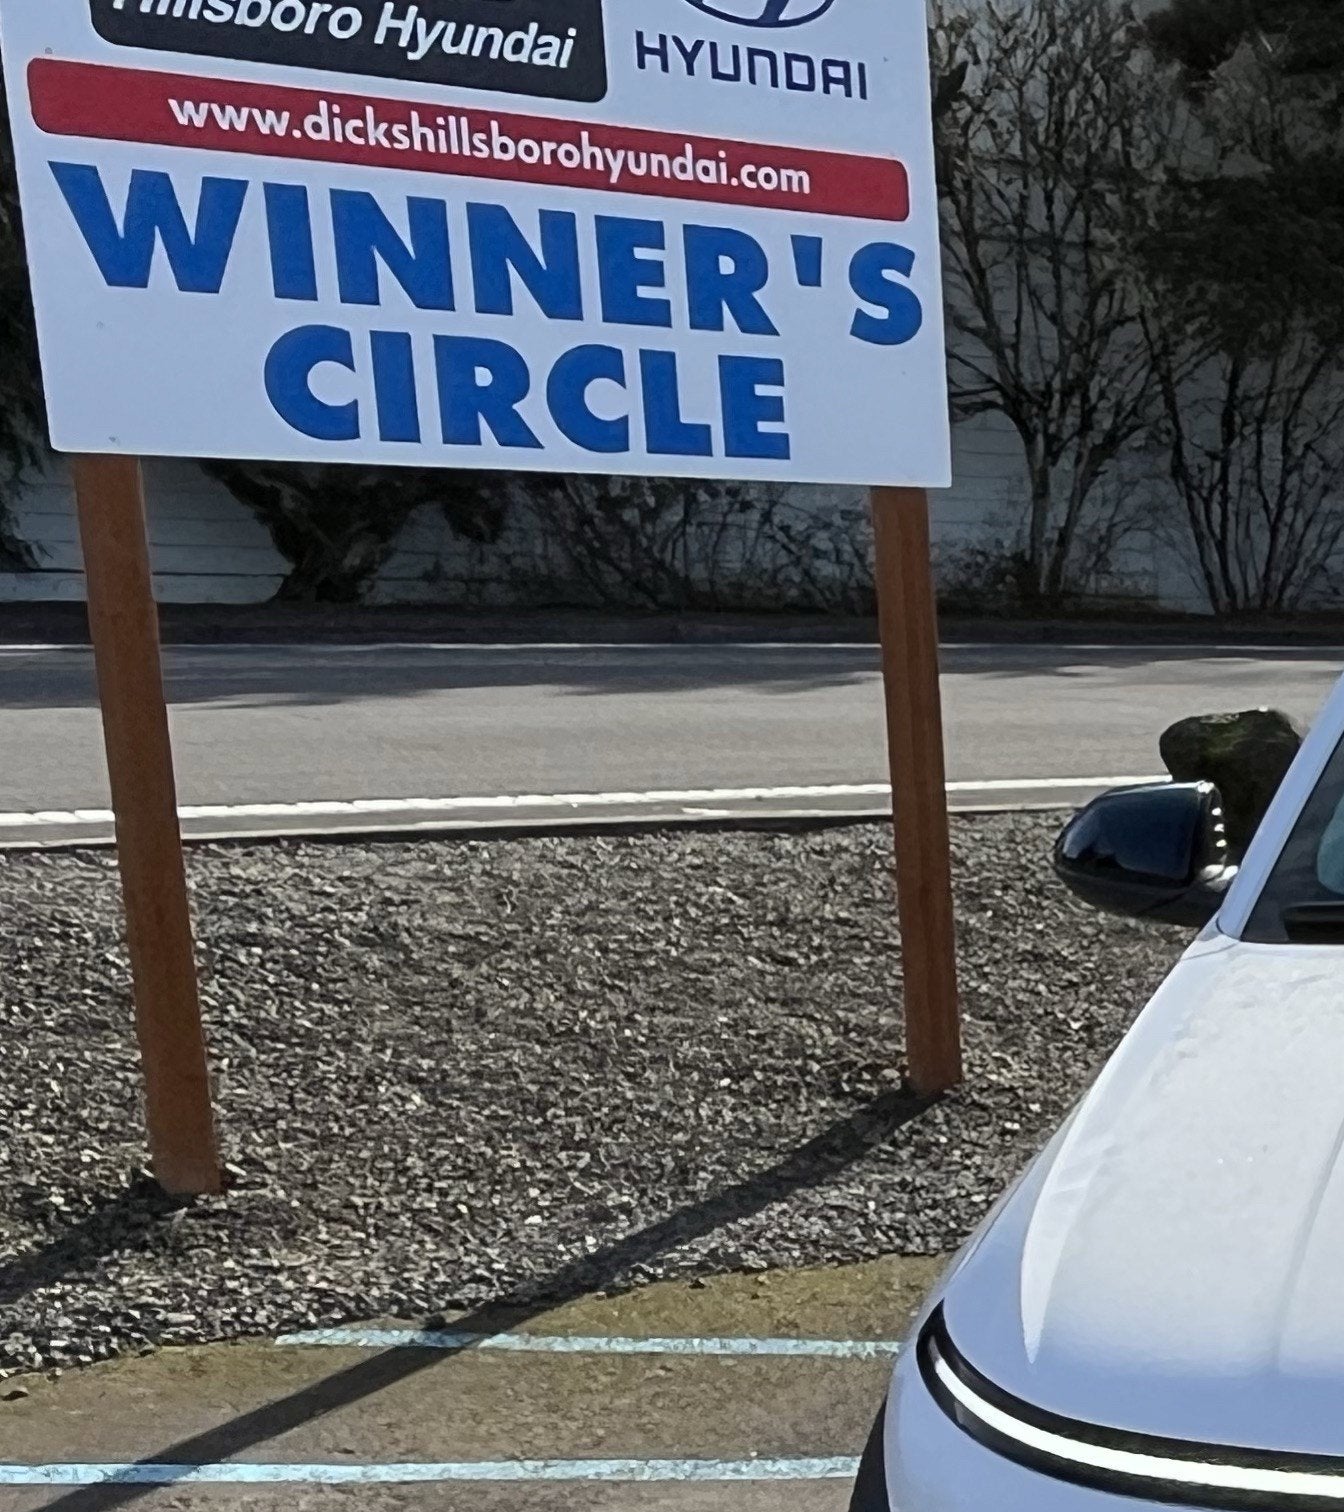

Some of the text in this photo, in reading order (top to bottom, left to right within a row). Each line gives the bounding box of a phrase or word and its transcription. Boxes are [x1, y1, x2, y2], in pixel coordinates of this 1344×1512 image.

[112, 0, 577, 68] sboro Hyundai
[635, 29, 868, 100] HYUNDAI
[168, 92, 811, 195] www.dickshillsborohyundai.com
[48, 160, 923, 345] WINNER'S
[264, 324, 791, 460] CIRCLE
